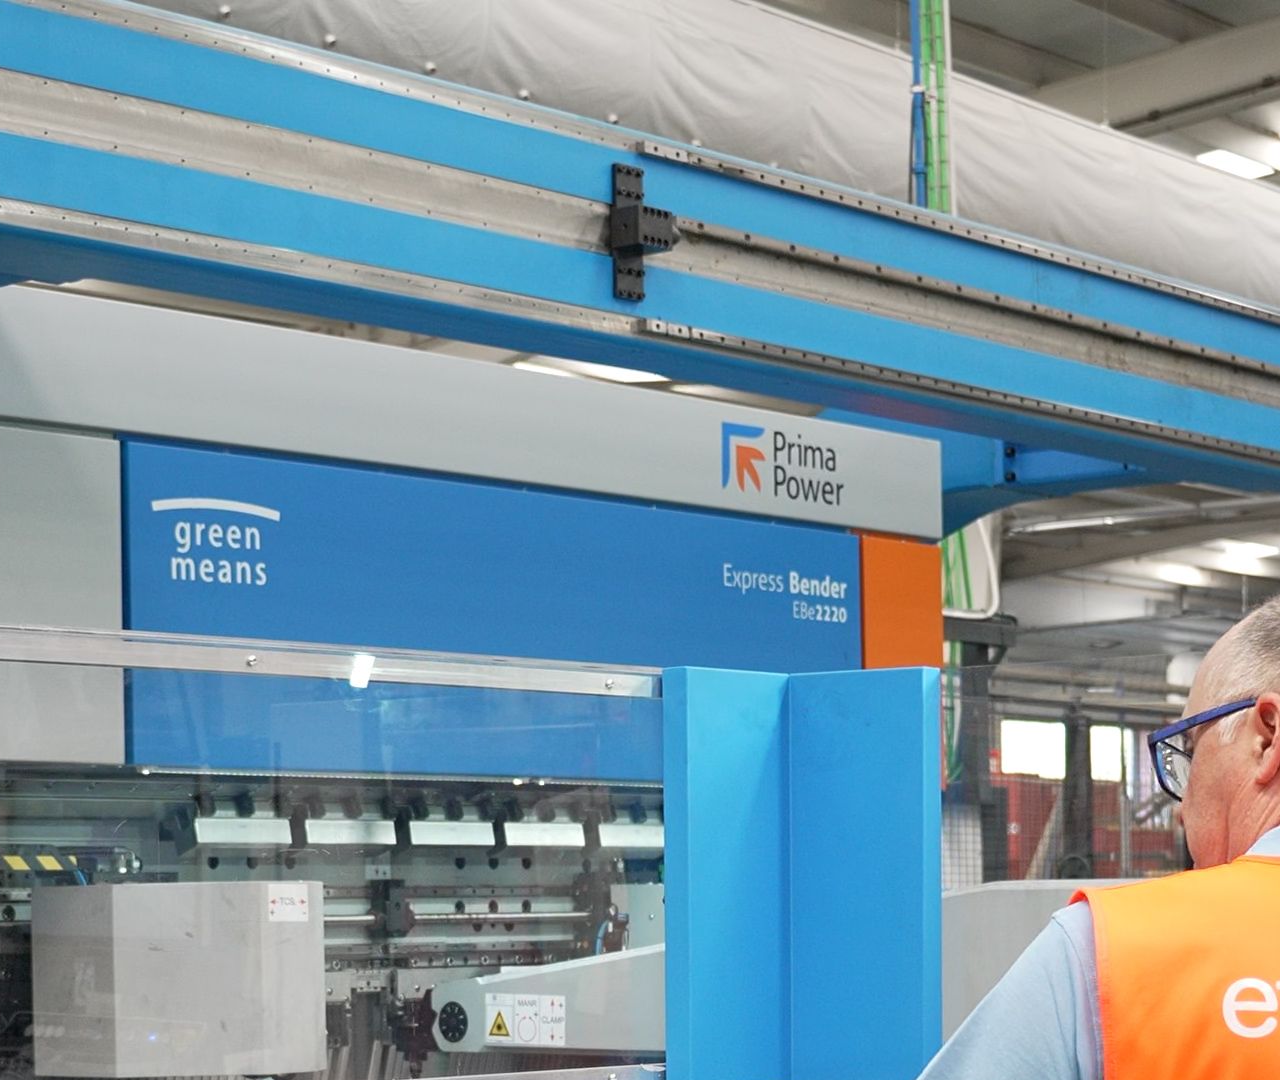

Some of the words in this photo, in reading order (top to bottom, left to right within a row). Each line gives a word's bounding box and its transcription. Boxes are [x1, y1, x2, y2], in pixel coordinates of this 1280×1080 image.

[773, 431, 836, 472] Prima
[774, 465, 844, 506] Power
[174, 521, 261, 553] green
[171, 557, 268, 585] means
[723, 563, 785, 595] Express
[788, 571, 847, 599] Bender
[793, 601, 848, 623] EBe2220
